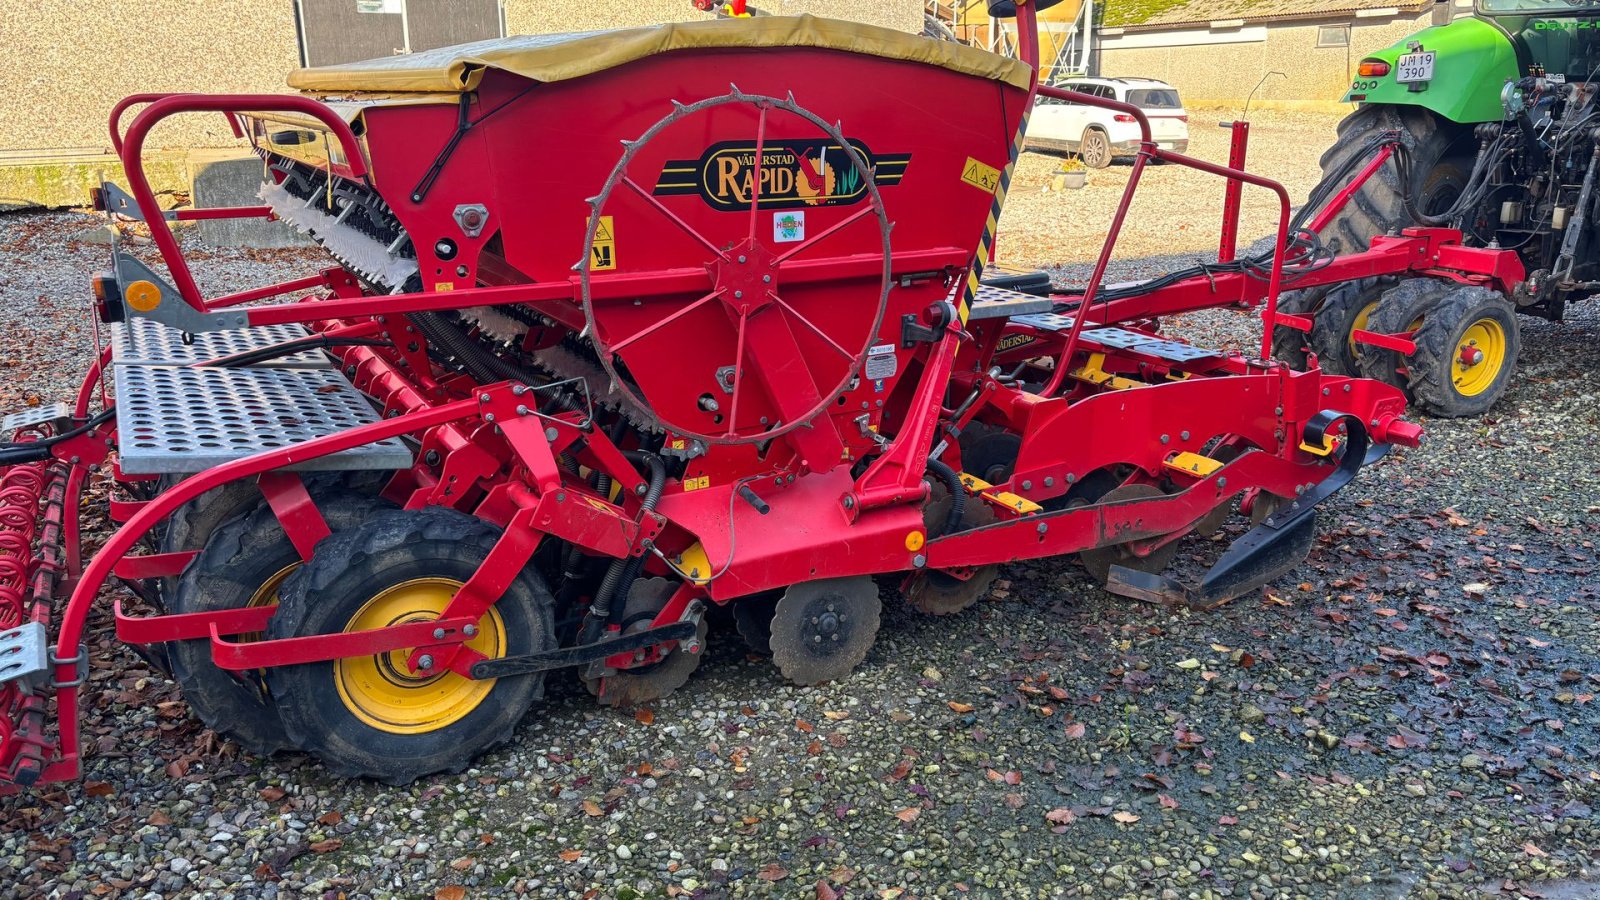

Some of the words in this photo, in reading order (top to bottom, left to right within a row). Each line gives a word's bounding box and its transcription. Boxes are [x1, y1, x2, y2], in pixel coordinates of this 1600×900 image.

[1400, 55, 1416, 67] JM
[1420, 54, 1432, 65] 19
[1403, 67, 1425, 79] 390
[737, 153, 795, 166] VÄDRSTAD
[716, 156, 794, 203] RAPID
